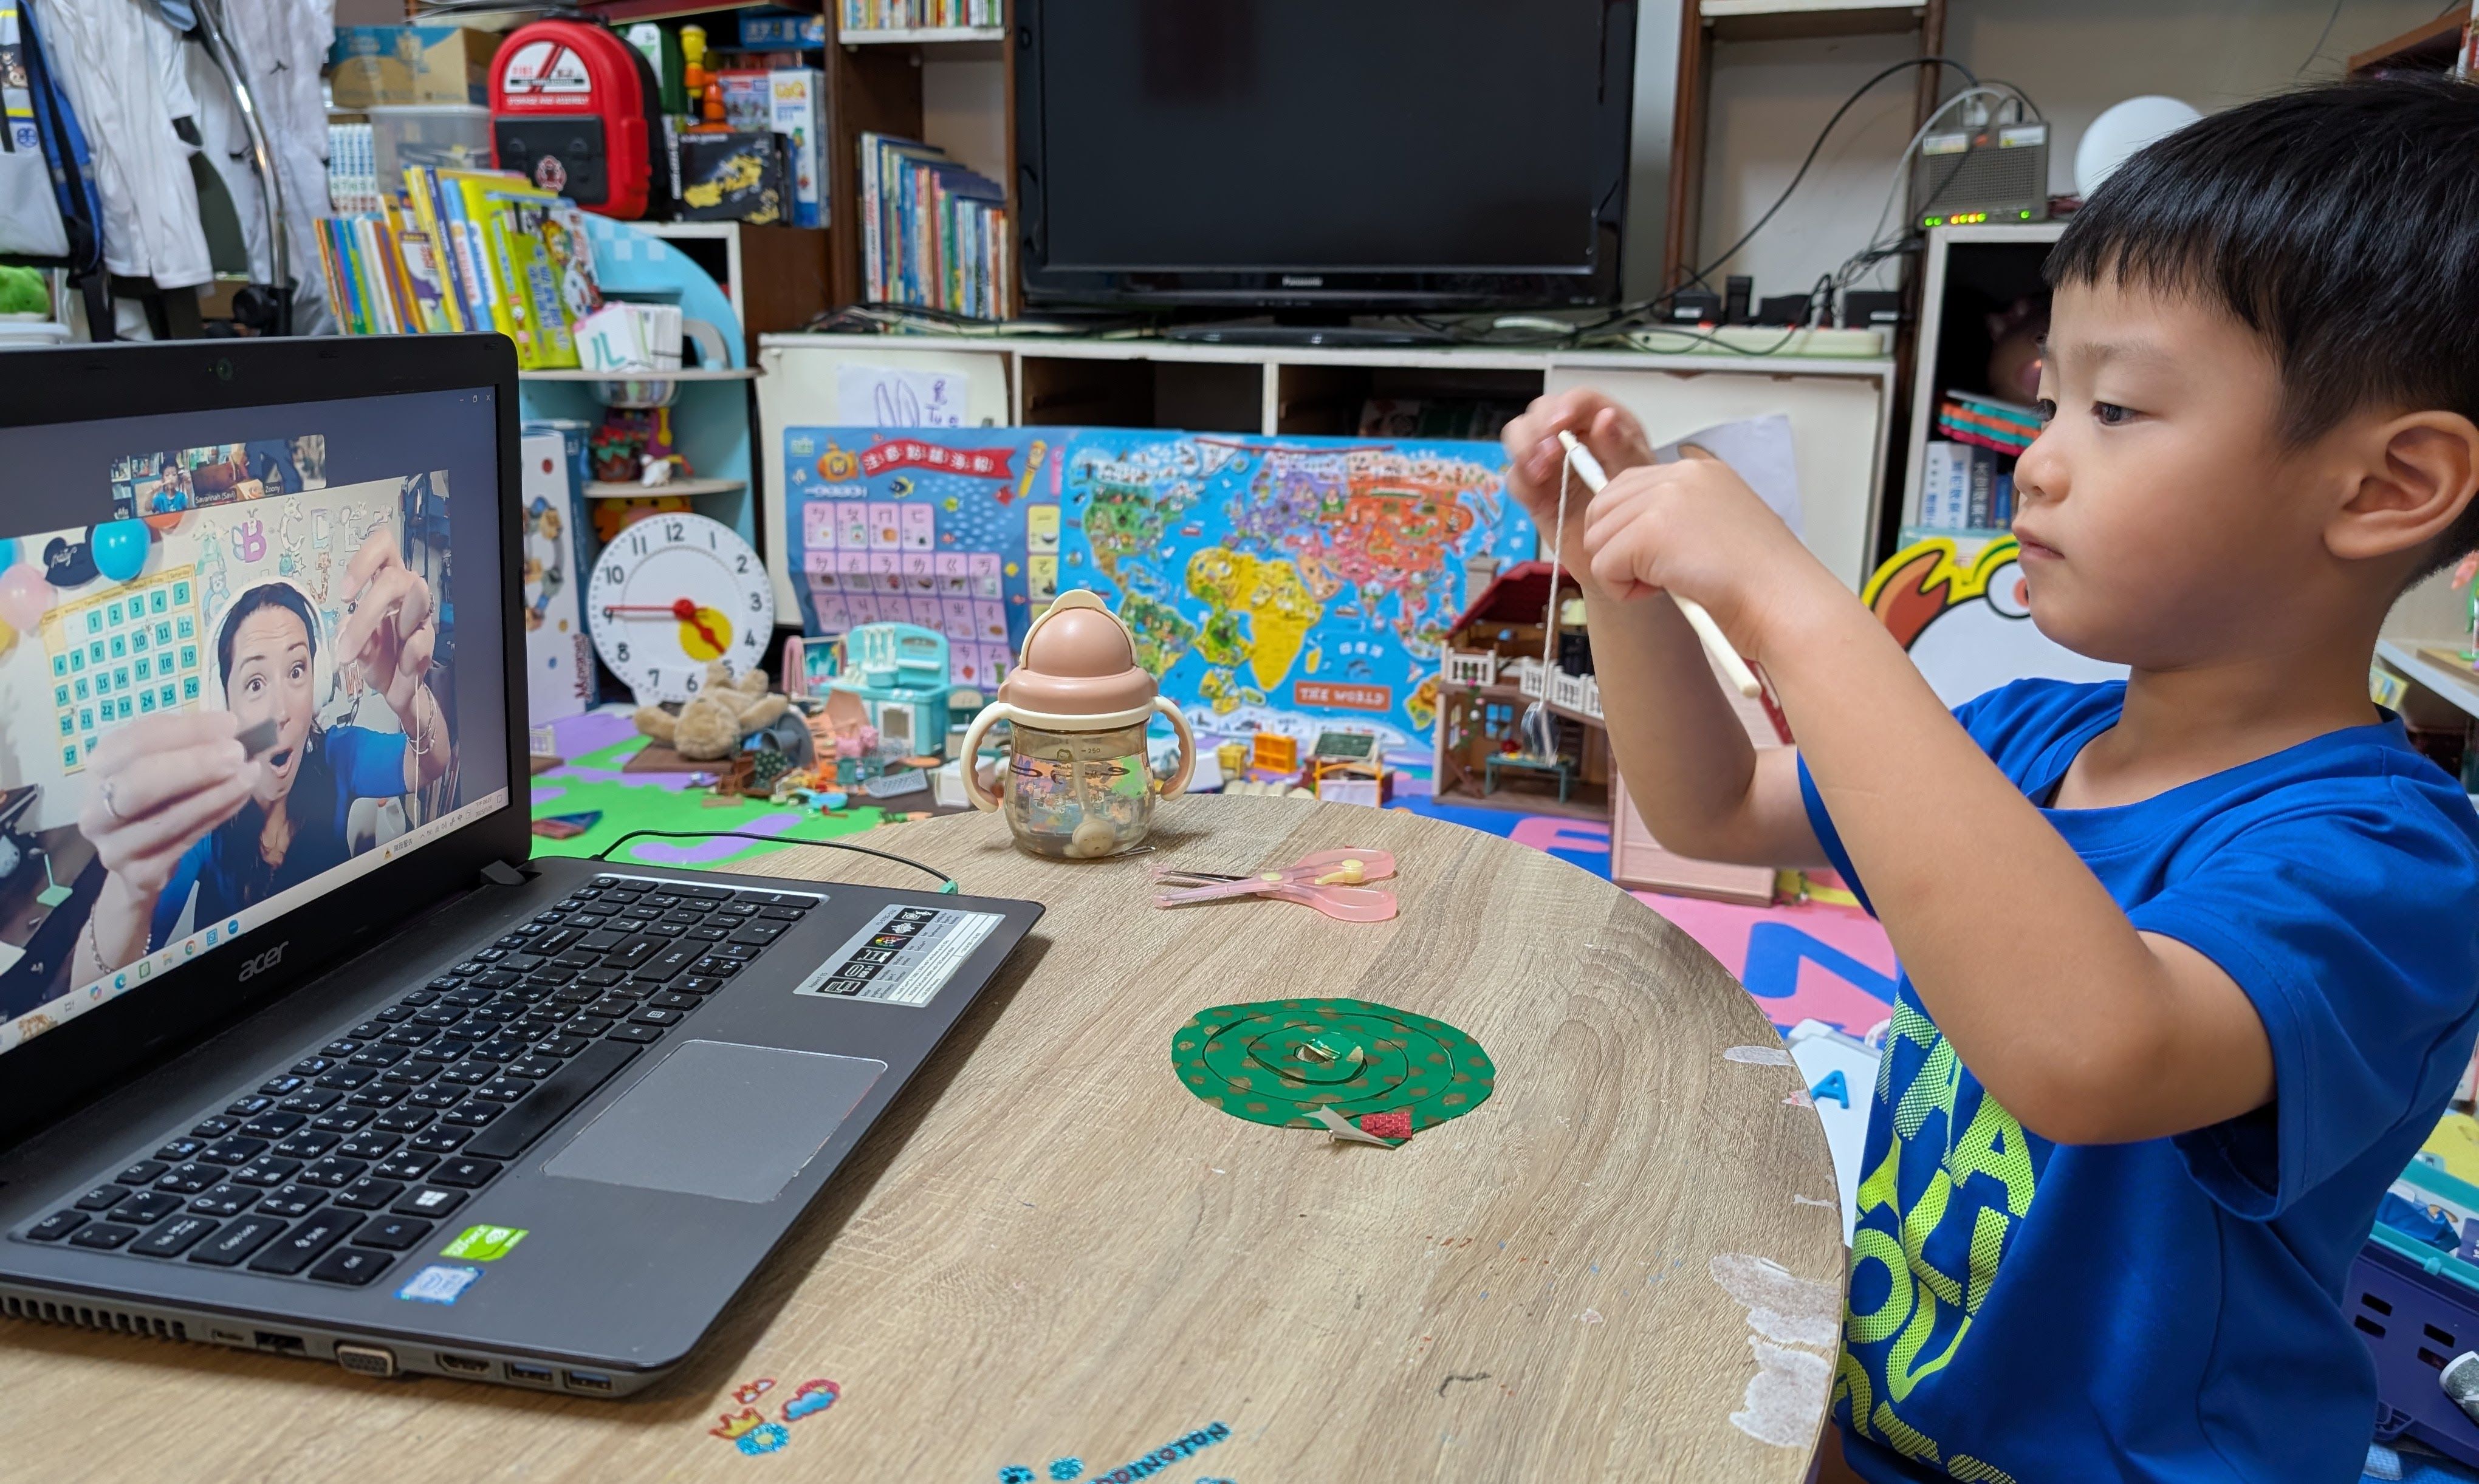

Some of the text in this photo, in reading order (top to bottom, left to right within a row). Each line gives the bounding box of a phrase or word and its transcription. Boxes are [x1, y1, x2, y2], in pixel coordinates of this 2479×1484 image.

[1282, 276, 1323, 287] Panasonic
[194, 493, 221, 504] Savannah
[242, 520, 267, 563] B
[665, 522, 684, 542] 12
[710, 531, 716, 549] 1
[632, 535, 647, 556] 11
[736, 554, 749, 573] 2
[605, 565, 625, 585] 10
[750, 592, 762, 611] 3
[603, 607, 614, 624] 9
[744, 629, 756, 647] 4
[617, 642, 629, 662] 8
[648, 668, 660, 687] 7
[722, 659, 735, 678] 5
[686, 672, 698, 692] 6
[1299, 687, 1385, 705] THE WORLD
[238, 940, 289, 982] acer
[808, 978, 820, 988] Aspire
[1811, 1070, 1850, 1110] A
